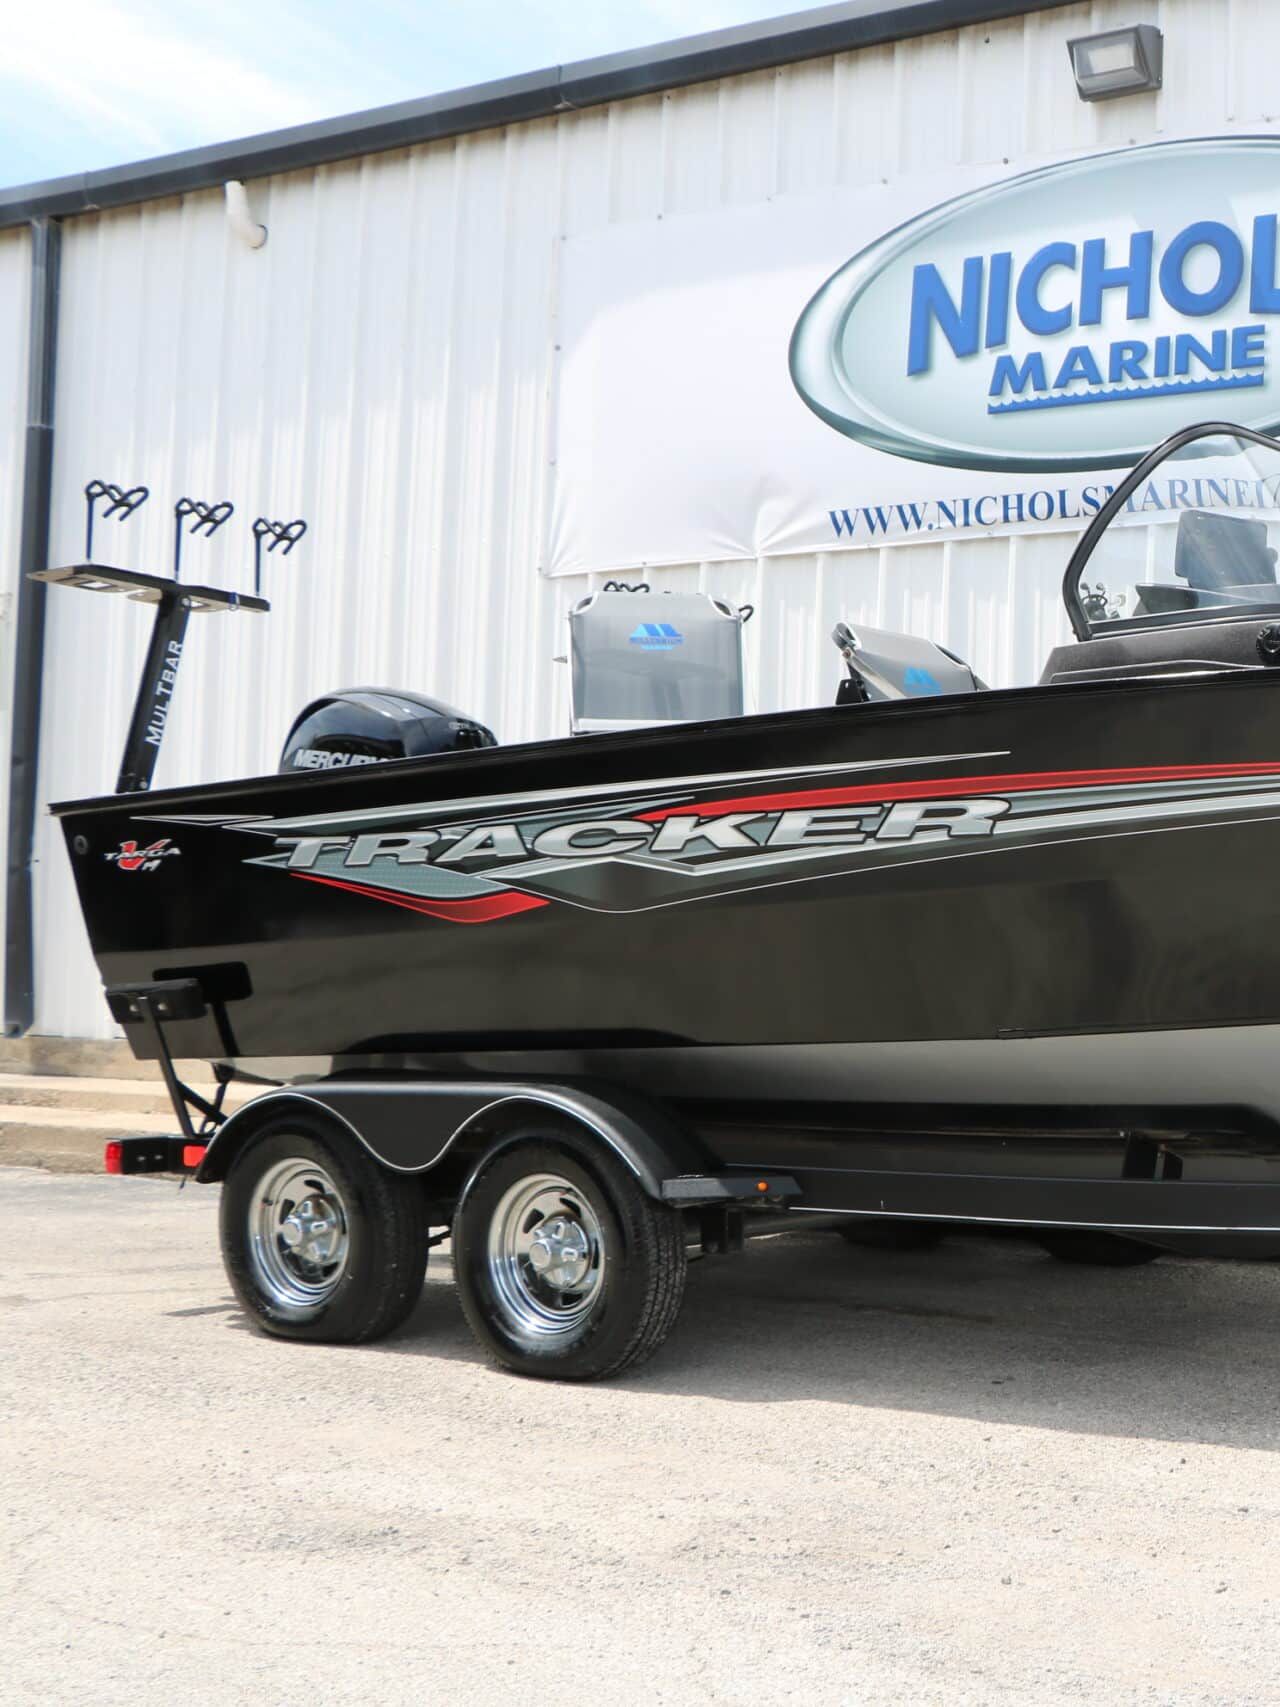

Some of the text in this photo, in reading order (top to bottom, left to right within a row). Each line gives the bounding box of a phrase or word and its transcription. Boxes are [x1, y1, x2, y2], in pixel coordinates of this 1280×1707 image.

[988, 324, 1266, 396] MARINE
[145, 640, 183, 746] MULTBAR
[293, 749, 390, 768] MERCUR
[272, 797, 1012, 868] TRACKER
